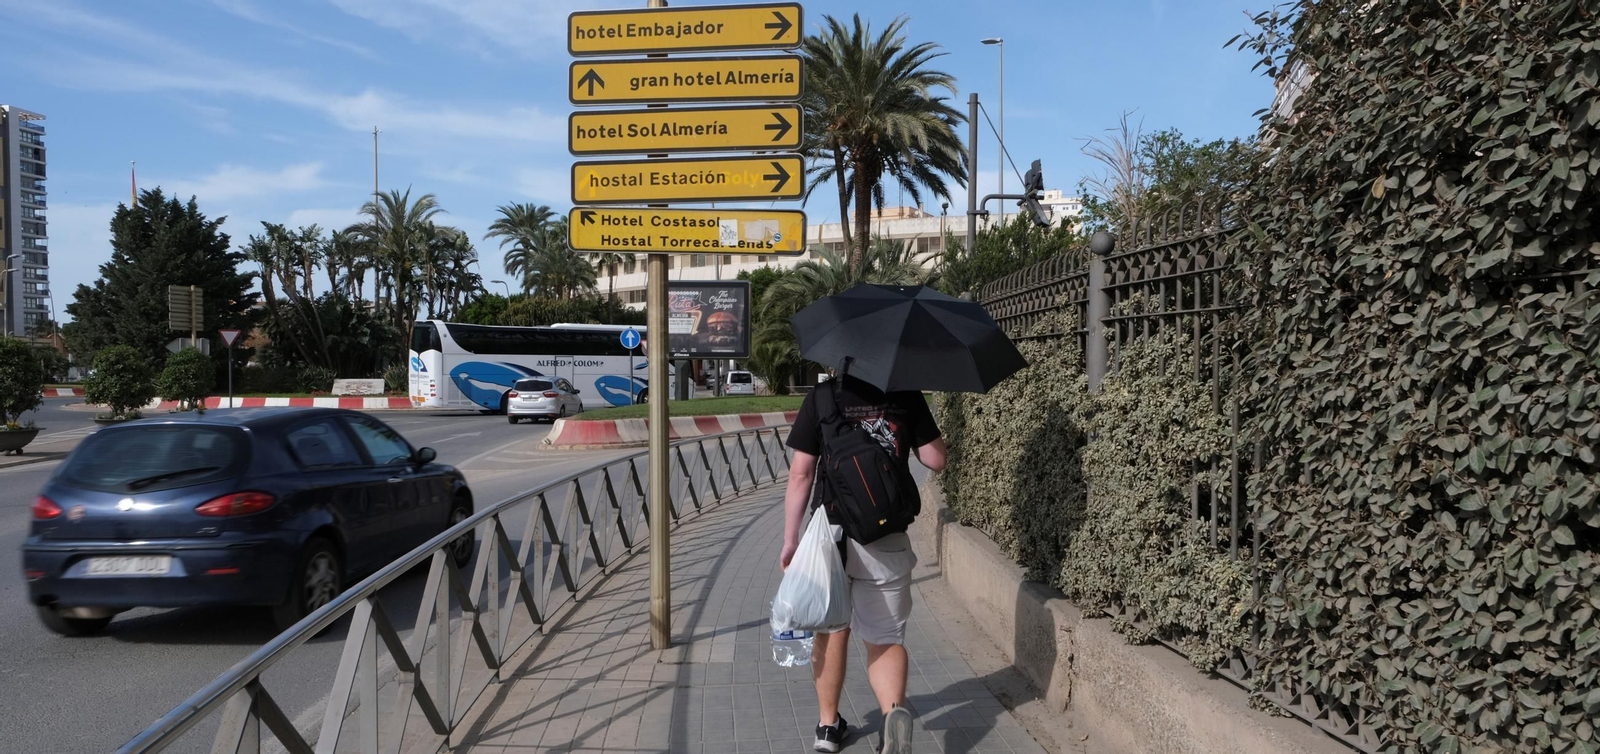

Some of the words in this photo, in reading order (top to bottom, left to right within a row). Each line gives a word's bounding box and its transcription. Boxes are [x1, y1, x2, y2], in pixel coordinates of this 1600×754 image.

[575, 24, 623, 40] hotel
[626, 21, 724, 39] Embajador
[629, 75, 669, 91] gran
[674, 71, 722, 86] hotel
[725, 68, 795, 85] Almería
[576, 124, 624, 139] hotel
[627, 122, 656, 137] Sol
[659, 120, 728, 136] Almería
[589, 172, 643, 188] hostal
[649, 170, 726, 186] Estación
[601, 214, 644, 227] Hotel
[651, 215, 721, 228] Costasol
[601, 234, 652, 247] Hostal
[660, 235, 774, 250] Torrecaenas
